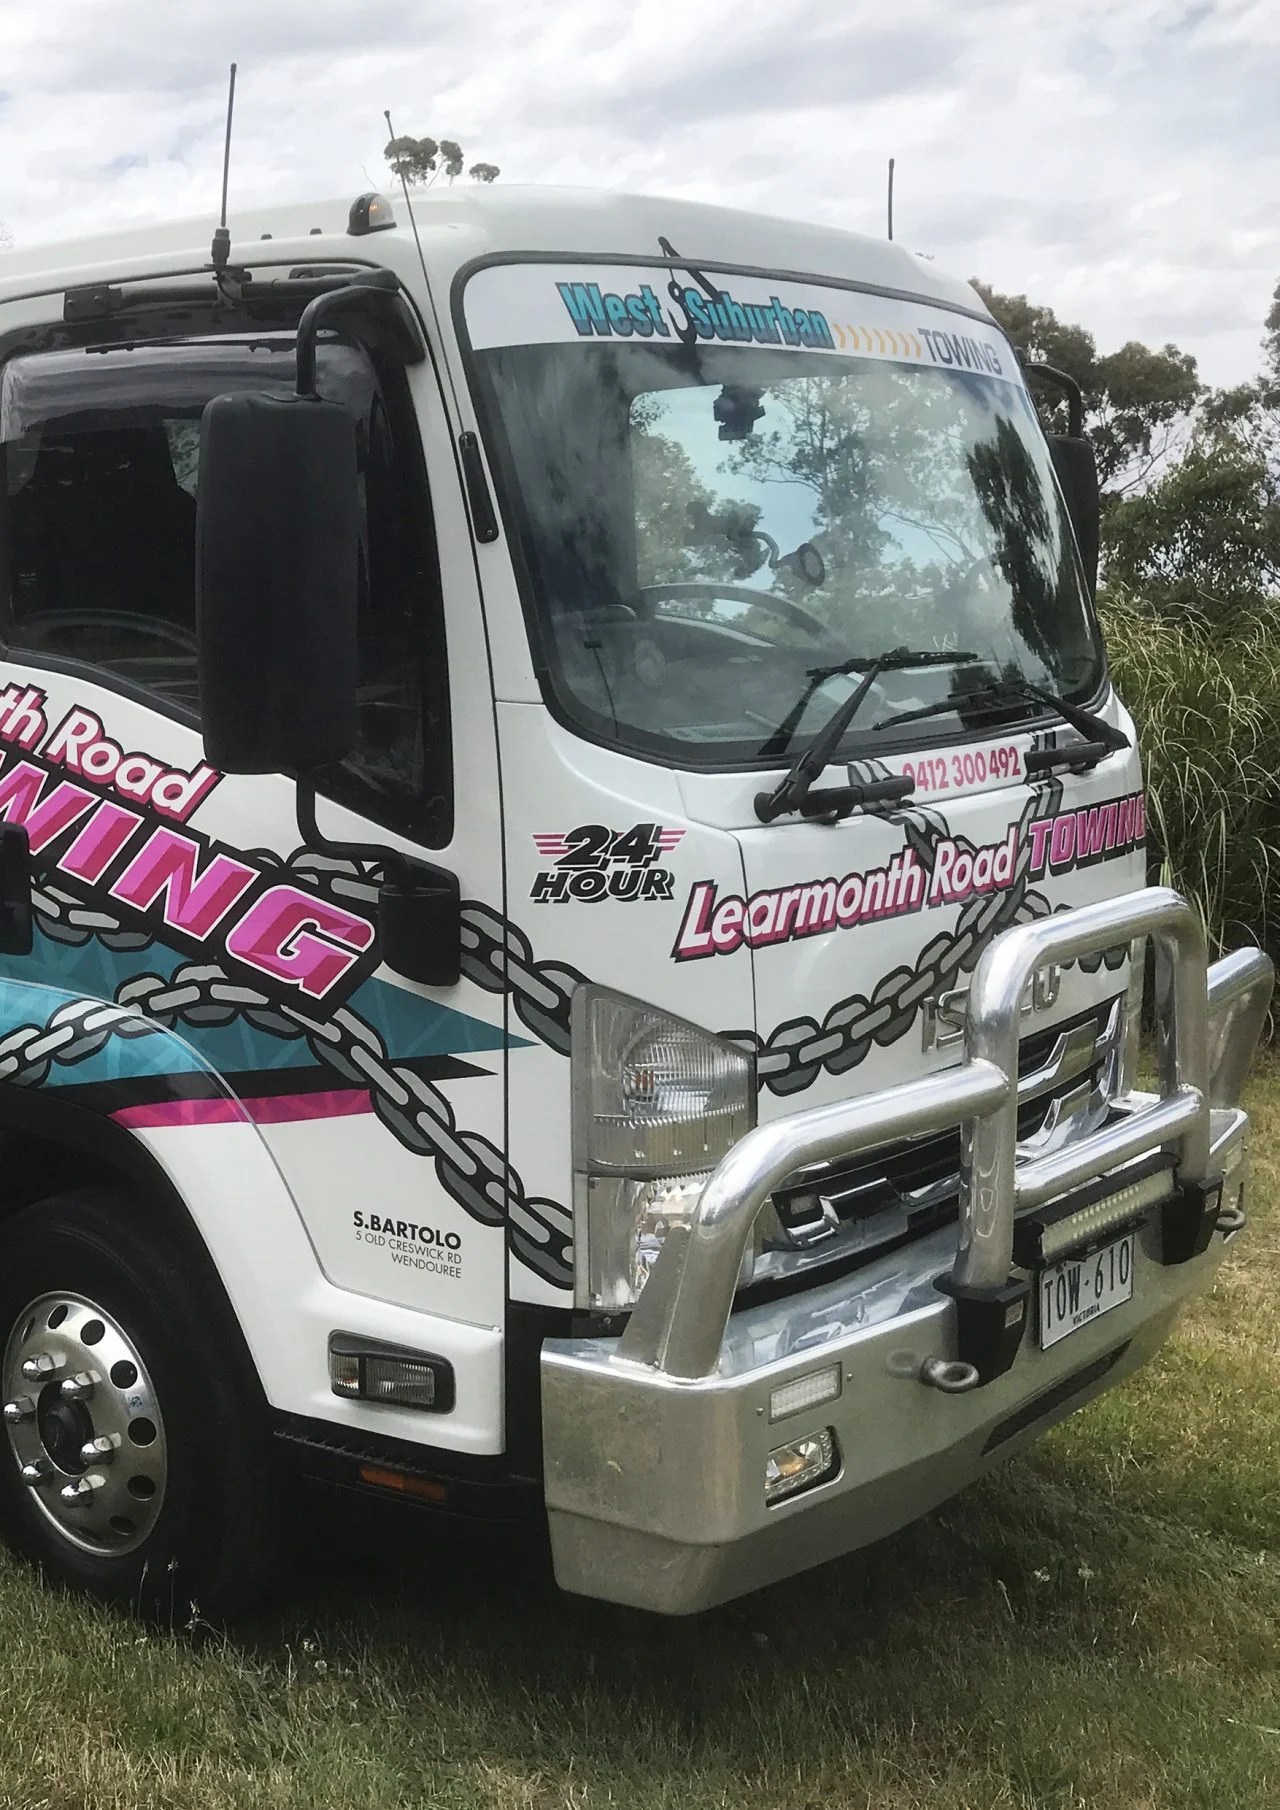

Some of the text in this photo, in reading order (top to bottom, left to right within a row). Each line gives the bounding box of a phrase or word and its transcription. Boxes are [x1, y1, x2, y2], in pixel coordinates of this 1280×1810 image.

[555, 282, 1002, 376] West Suburban TOWING
[44, 704, 224, 824] Road
[952, 751, 987, 787] 300
[989, 746, 1021, 779] 492
[553, 823, 663, 870] 24
[529, 868, 675, 904] HOUR
[672, 846, 925, 962] Learmonth
[927, 821, 1020, 908] Road
[353, 1210, 461, 1250] S.BARTOLO
[355, 1230, 462, 1265] 5 OLD CRESWICK RD
[391, 1252, 462, 1279] WENDOUREE
